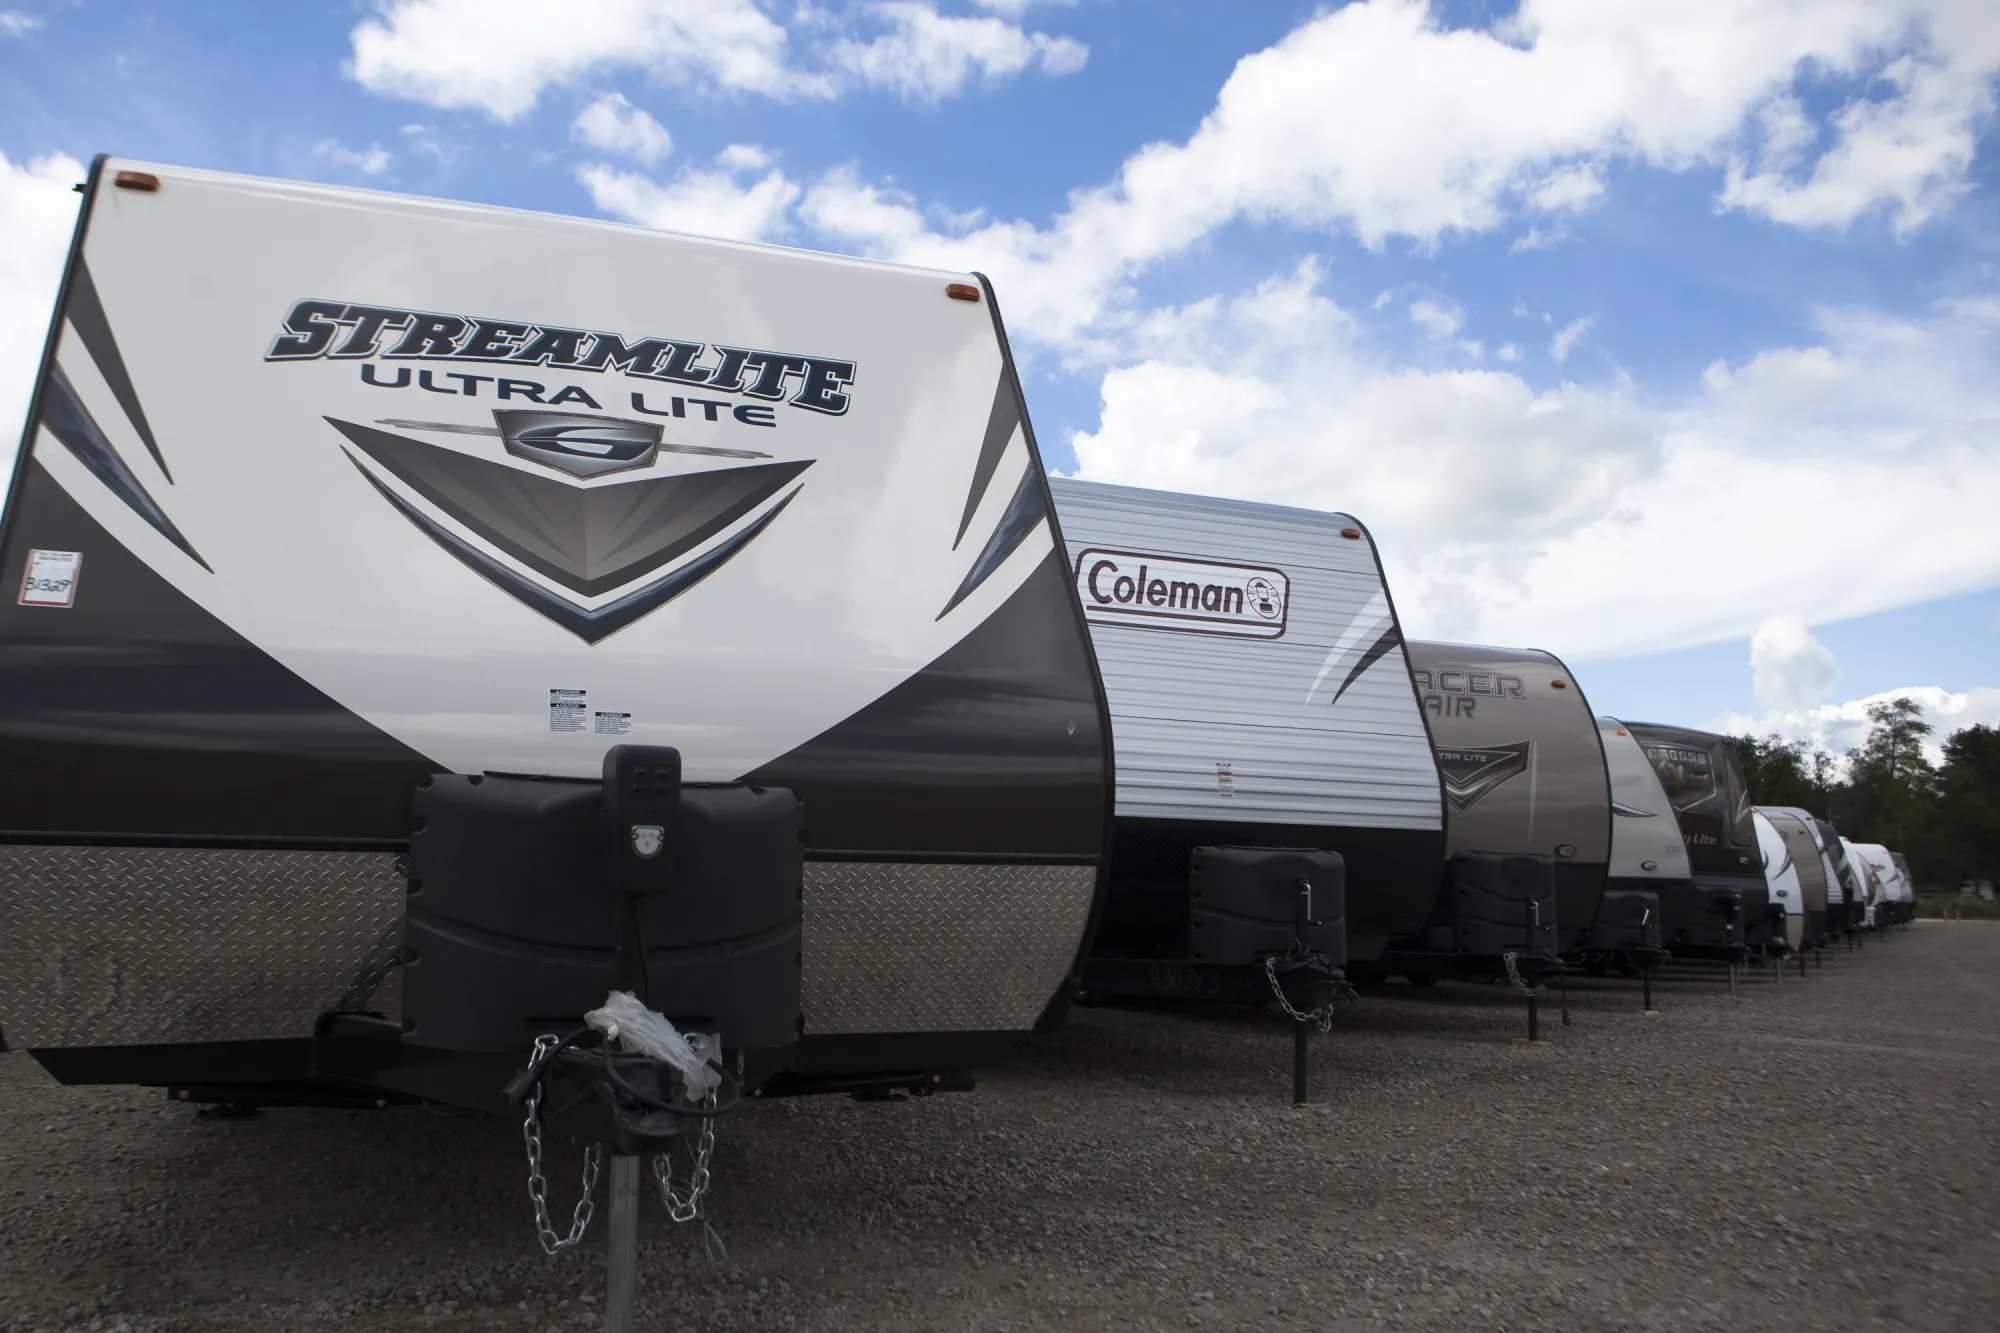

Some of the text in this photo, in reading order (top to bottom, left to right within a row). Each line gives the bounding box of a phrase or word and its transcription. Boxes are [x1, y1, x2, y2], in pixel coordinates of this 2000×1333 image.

[264, 298, 857, 416] STREAMLITE
[360, 363, 776, 428] ULTRA LITE
[1087, 559, 1244, 614] Coleman
[1423, 694, 1477, 719] AIR
[1463, 754, 1488, 762] LITE
[1693, 832, 1717, 845] Lite
